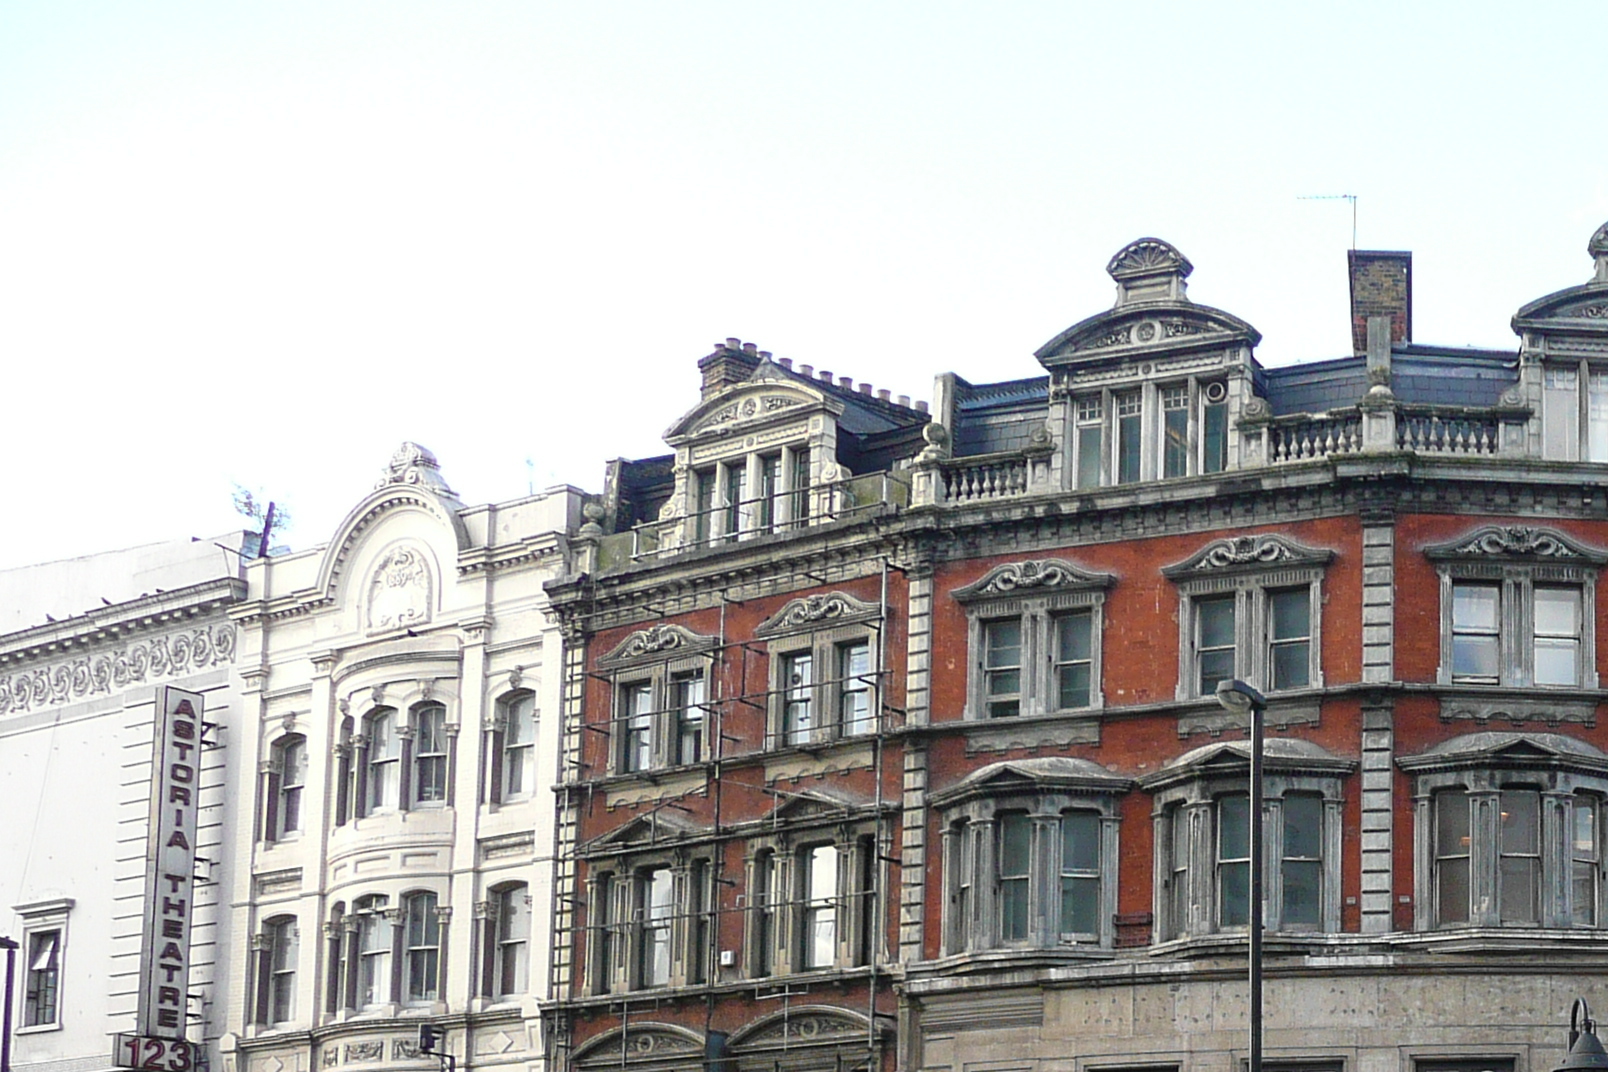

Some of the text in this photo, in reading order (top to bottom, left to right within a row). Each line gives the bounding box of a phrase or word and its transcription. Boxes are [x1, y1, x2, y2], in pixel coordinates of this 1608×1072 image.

[166, 699, 196, 851] ASTORIA
[157, 873, 186, 1029] THEATRE
[125, 1037, 192, 1072] 123
